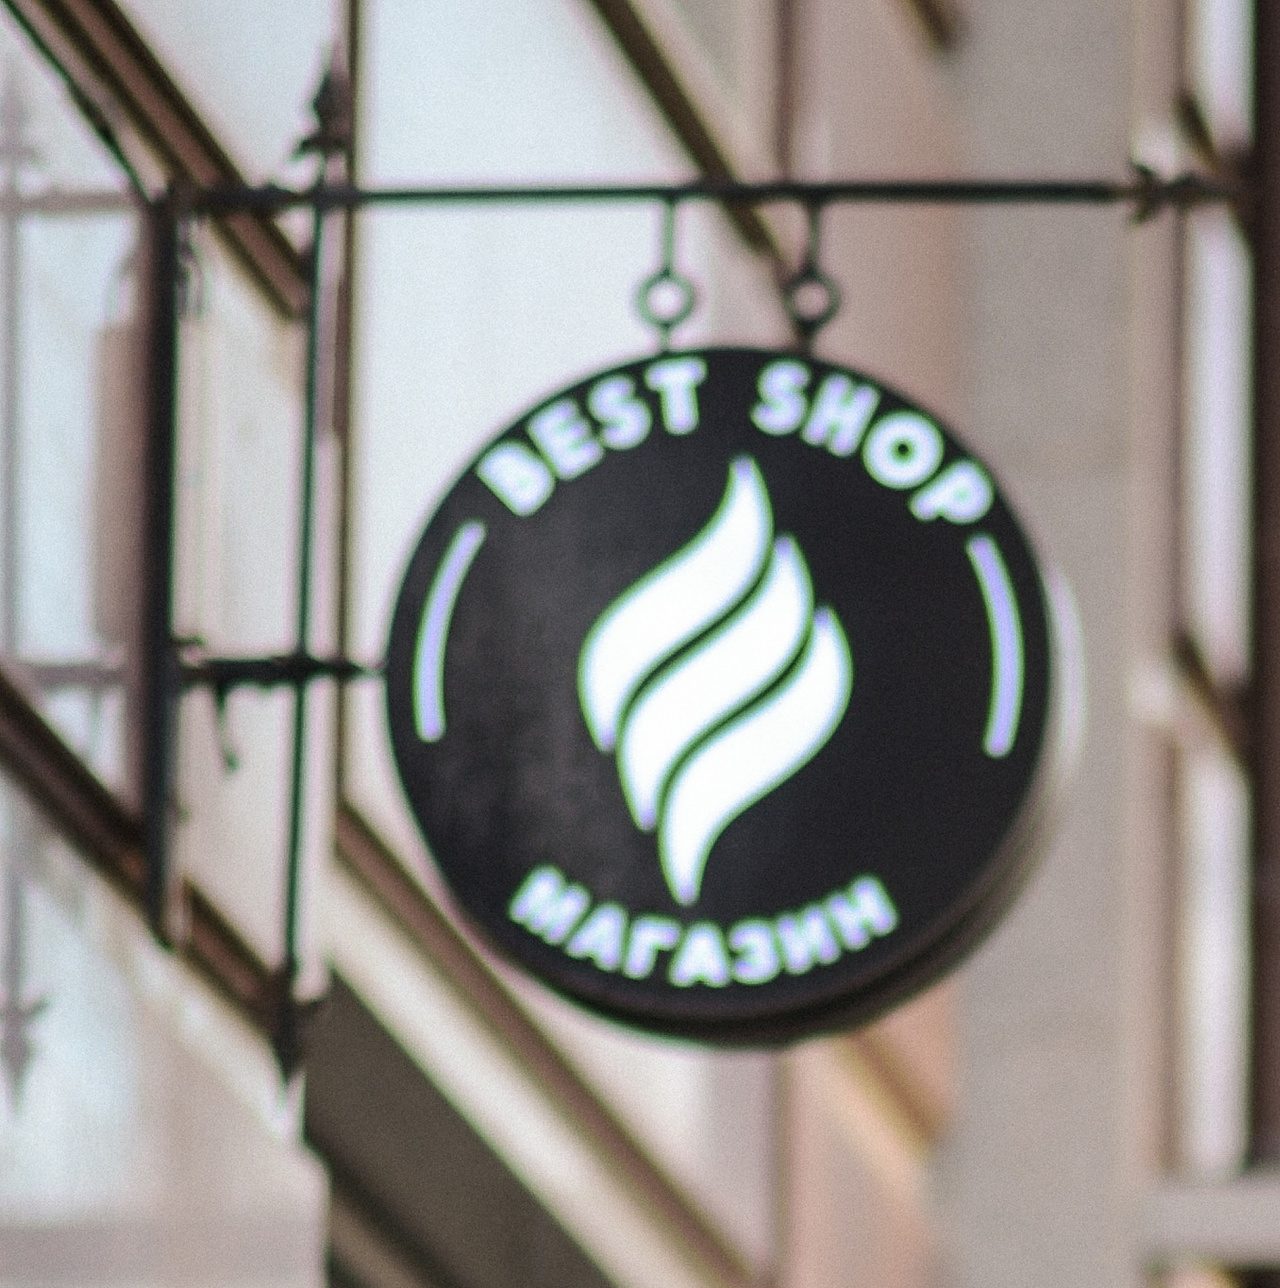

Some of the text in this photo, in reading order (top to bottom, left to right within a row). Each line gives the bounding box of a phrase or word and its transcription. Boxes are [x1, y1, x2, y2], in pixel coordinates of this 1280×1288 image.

[476, 356, 995, 524] BEST SHOP
[508, 864, 900, 988] МАГАЗИН
